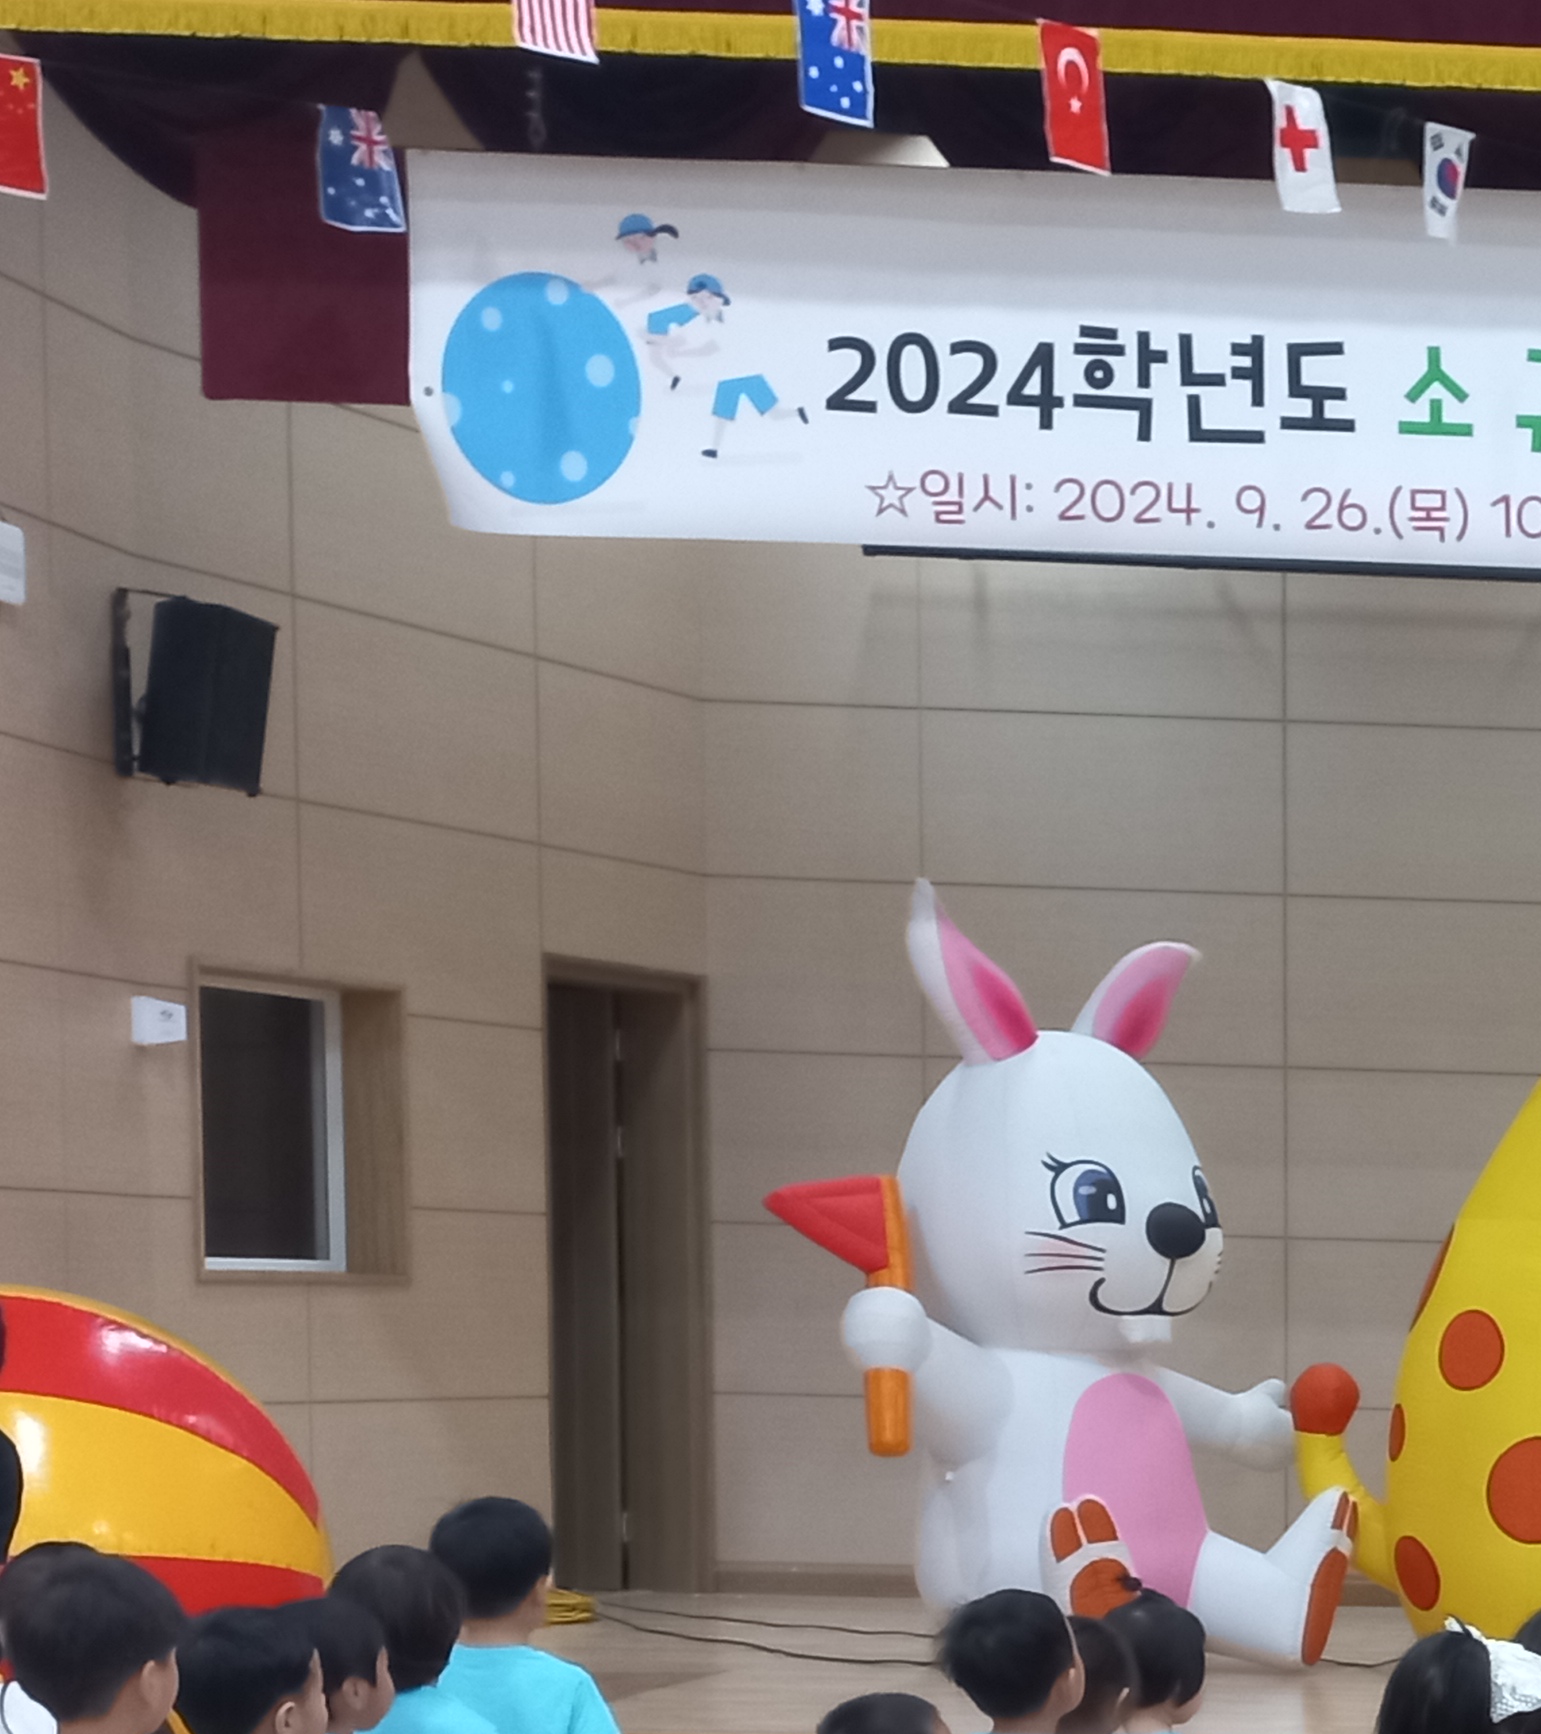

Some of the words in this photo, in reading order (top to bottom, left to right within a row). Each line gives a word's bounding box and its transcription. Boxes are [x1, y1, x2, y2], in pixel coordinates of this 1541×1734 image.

[826, 325, 1357, 445] 2024학년도
[920, 470, 1034, 526] 일시:
[1055, 479, 1216, 530] 2024.
[1237, 486, 1281, 532] 9.
[1302, 486, 1470, 545] 26.(목)
